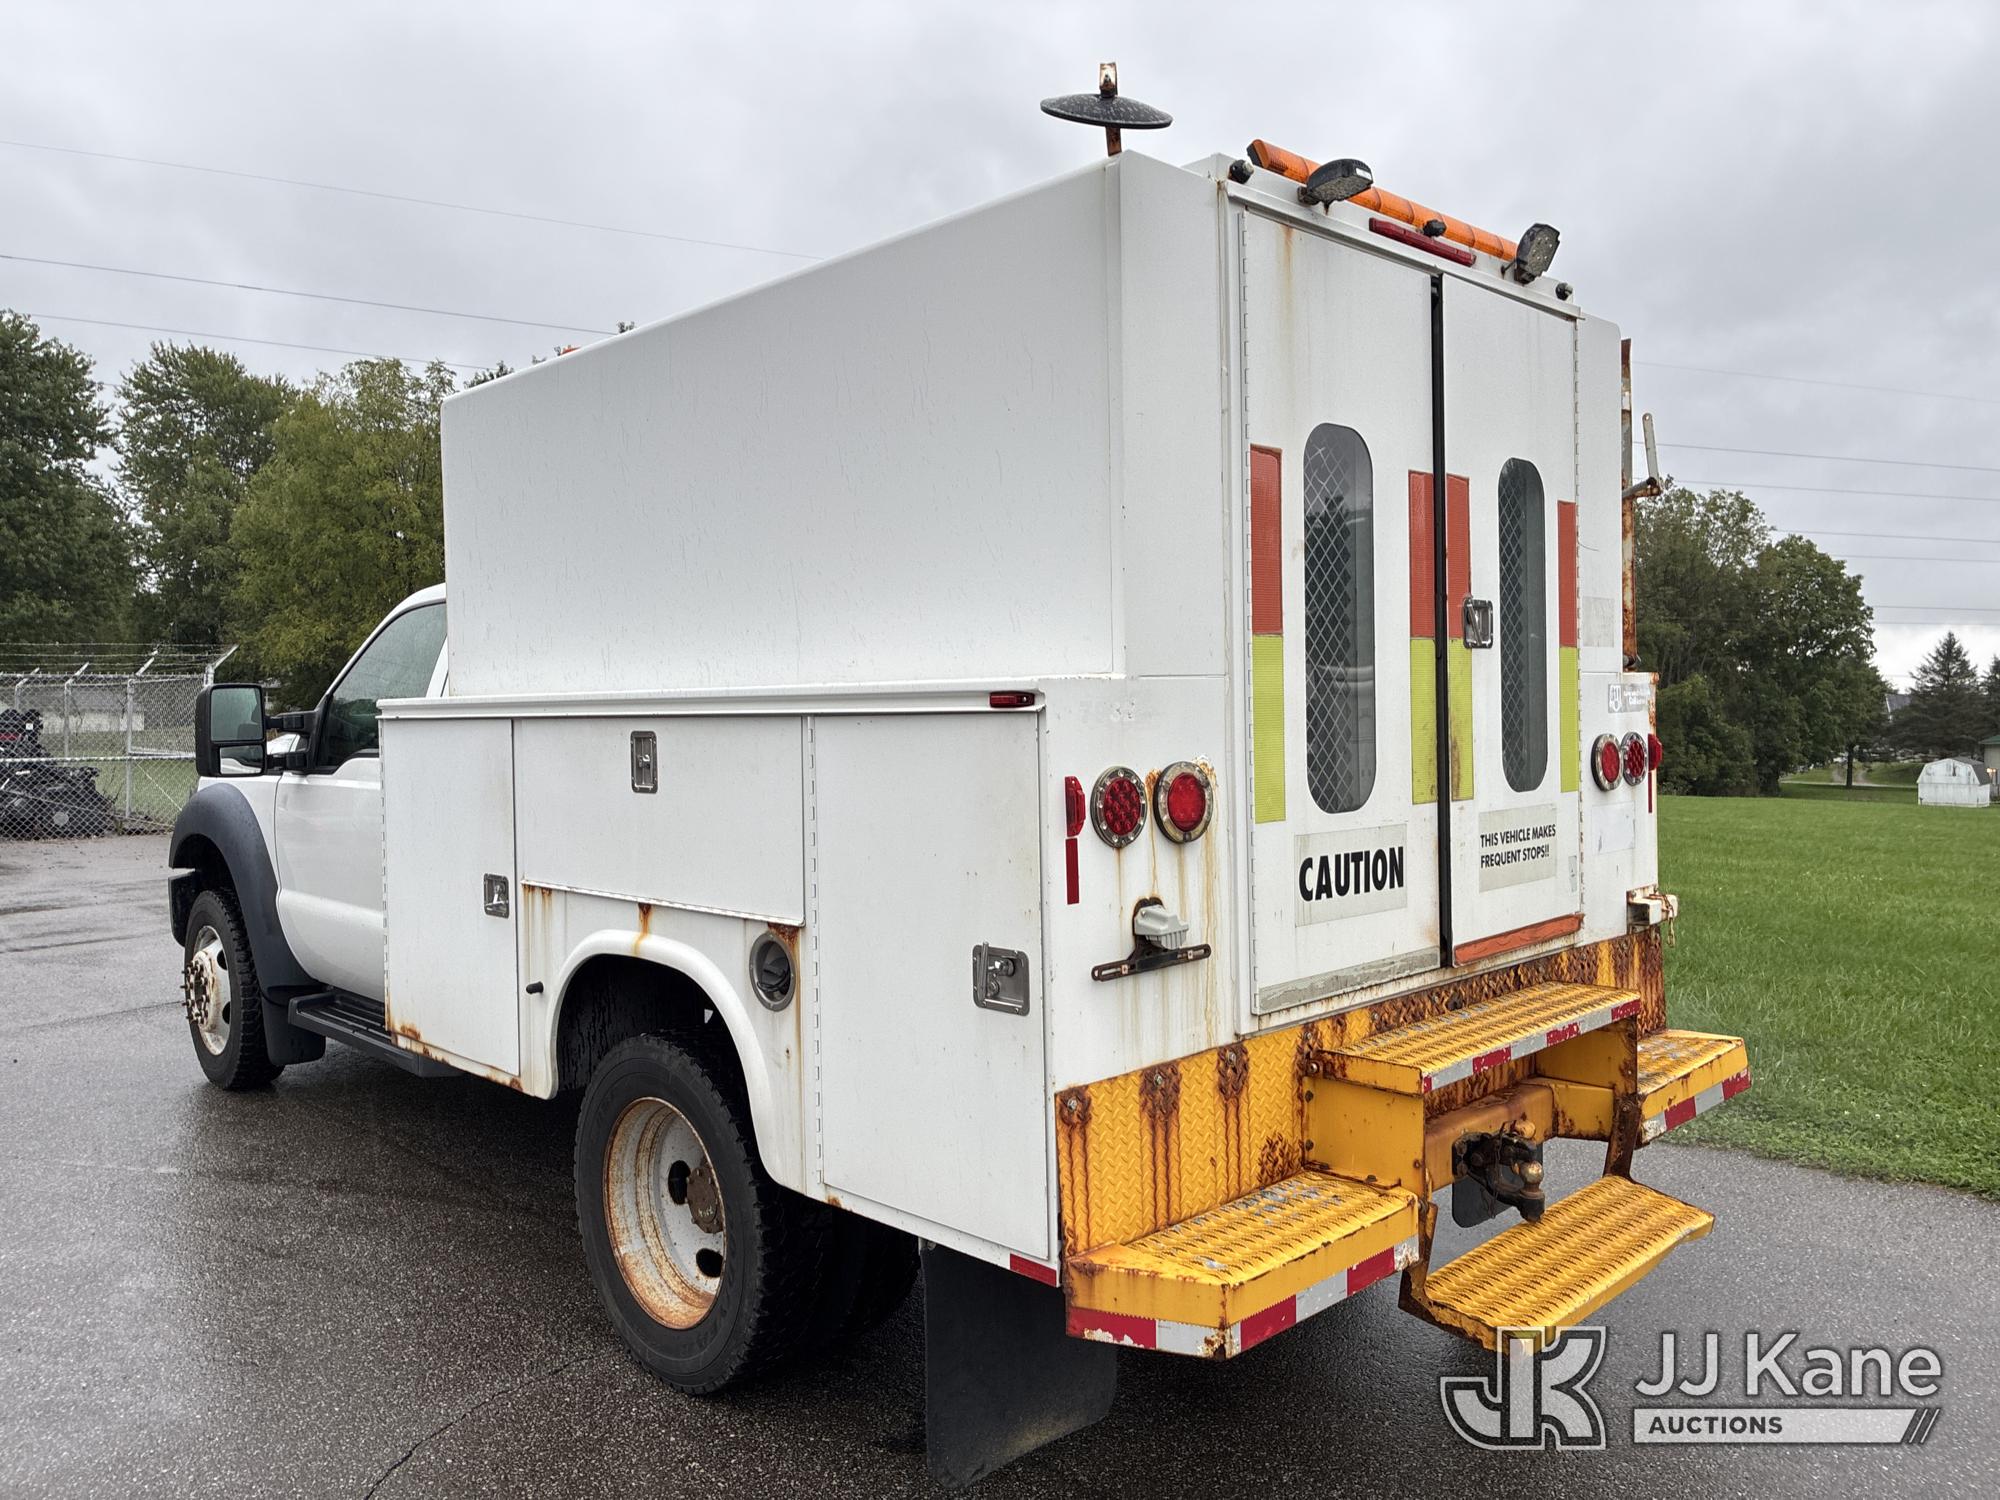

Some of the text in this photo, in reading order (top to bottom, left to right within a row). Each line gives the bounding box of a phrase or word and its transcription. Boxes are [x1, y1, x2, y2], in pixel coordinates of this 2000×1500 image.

[1480, 824, 1556, 848] THIS VEHICLE MAKES
[1480, 849, 1521, 869] FREQUENT
[1299, 846, 1404, 902] CAUTION
